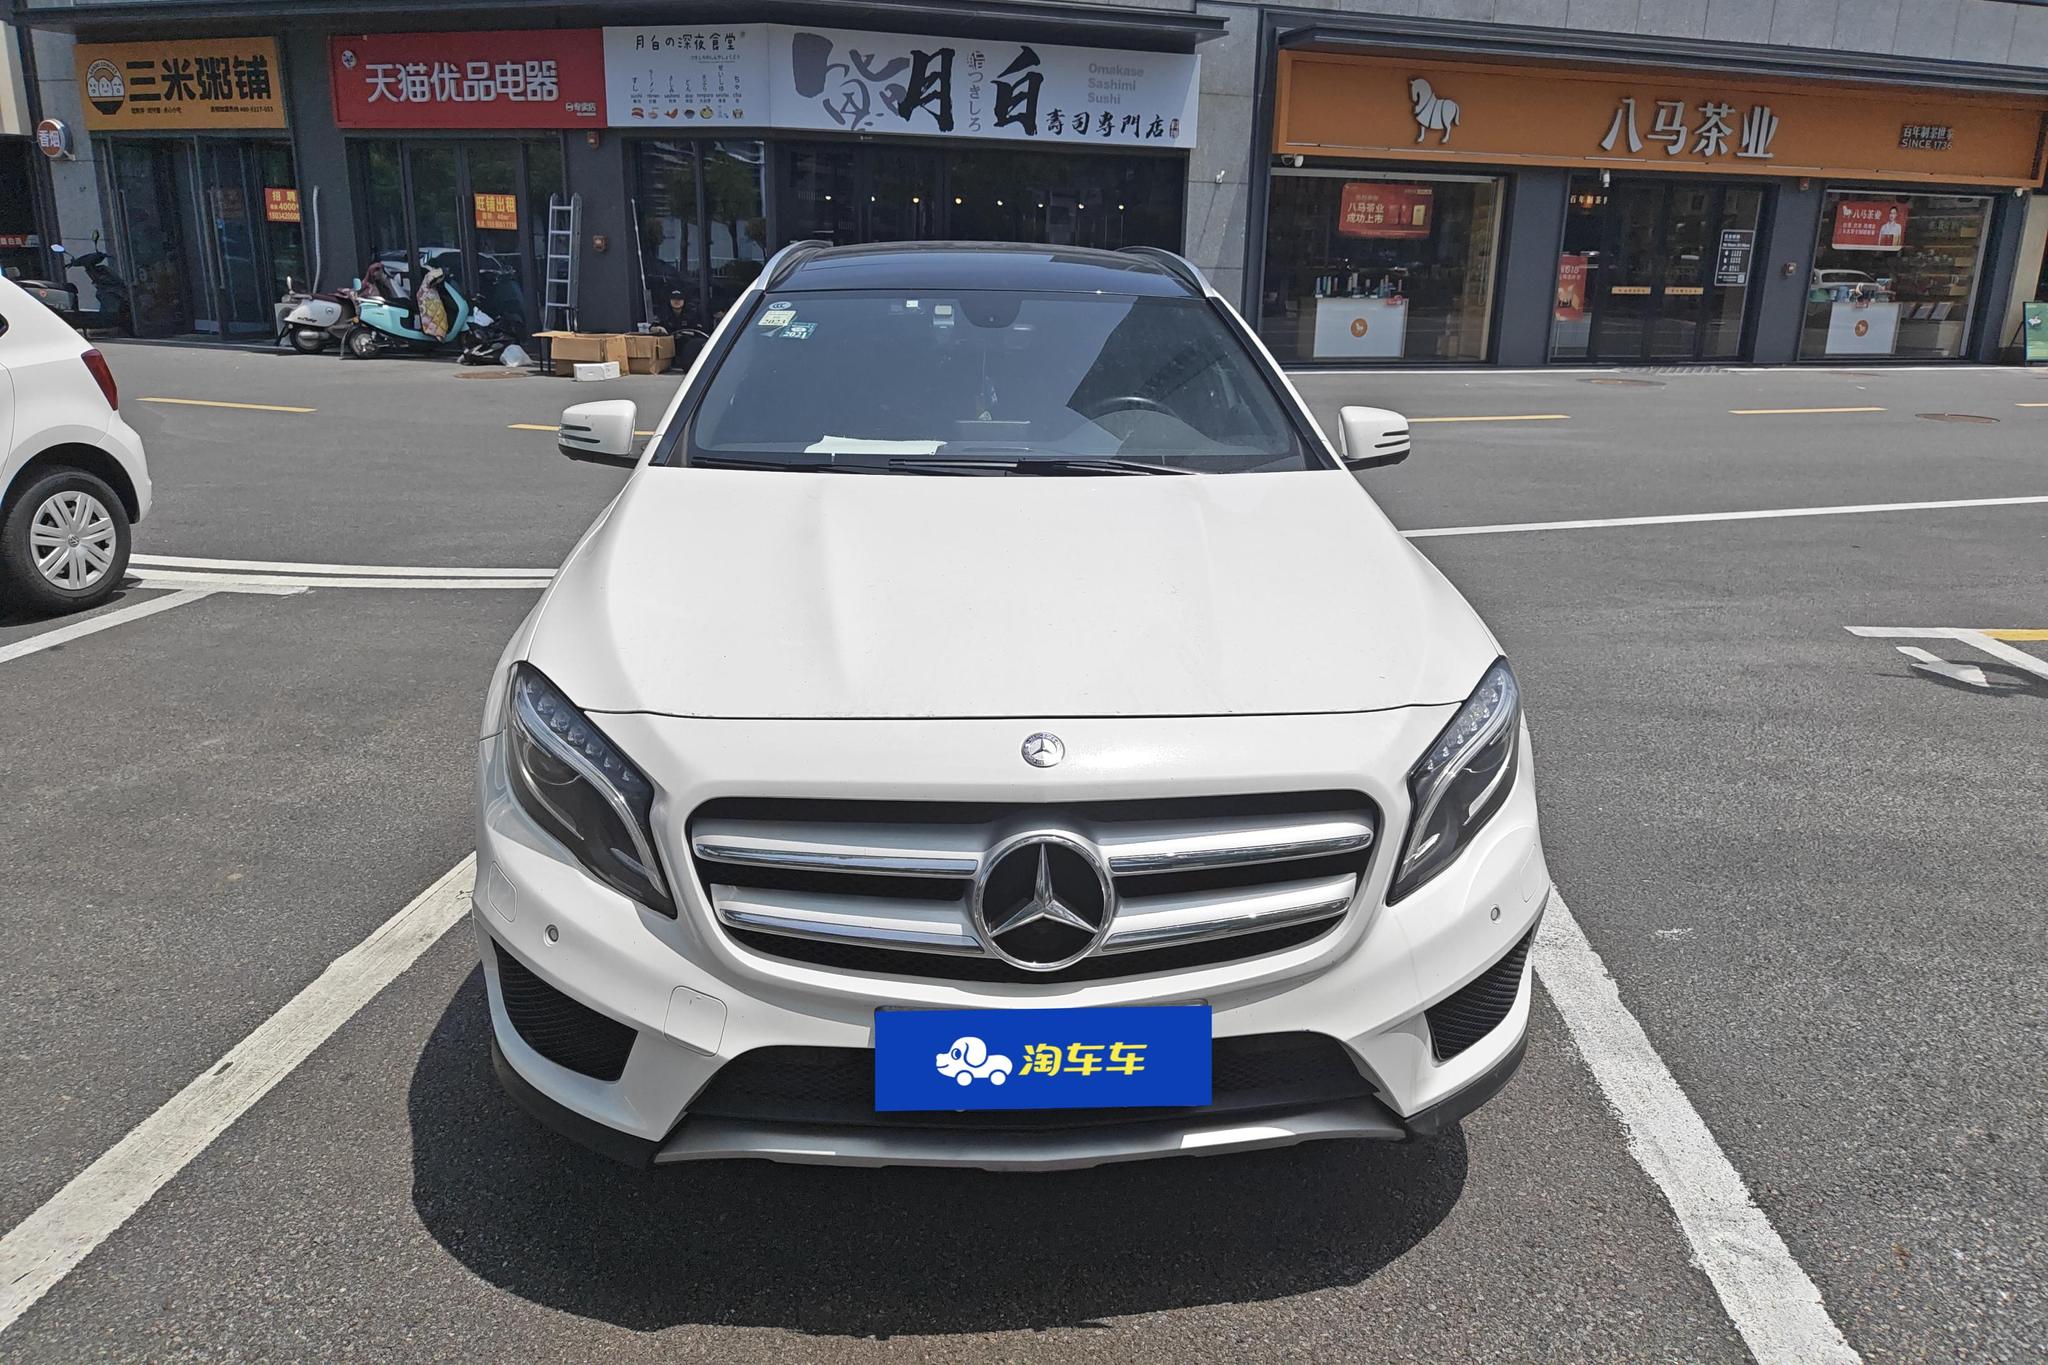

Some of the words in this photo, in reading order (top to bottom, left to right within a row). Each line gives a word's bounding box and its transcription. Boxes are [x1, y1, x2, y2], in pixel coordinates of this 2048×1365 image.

[635, 32, 736, 51] 月白の深夜食堂
[1088, 63, 1144, 77] Omakase
[126, 54, 271, 102] 三米粥铺
[365, 60, 559, 103] 天猫优品电器
[1088, 78, 1136, 91] Sashimi
[1088, 92, 1121, 105] Sushi
[1600, 98, 1779, 158] 八马茶业
[39, 129, 60, 148] 香烟
[1902, 138, 1932, 150] SINCE
[1347, 202, 1385, 214] 八马茶业
[1346, 213, 1385, 224] 成功上市
